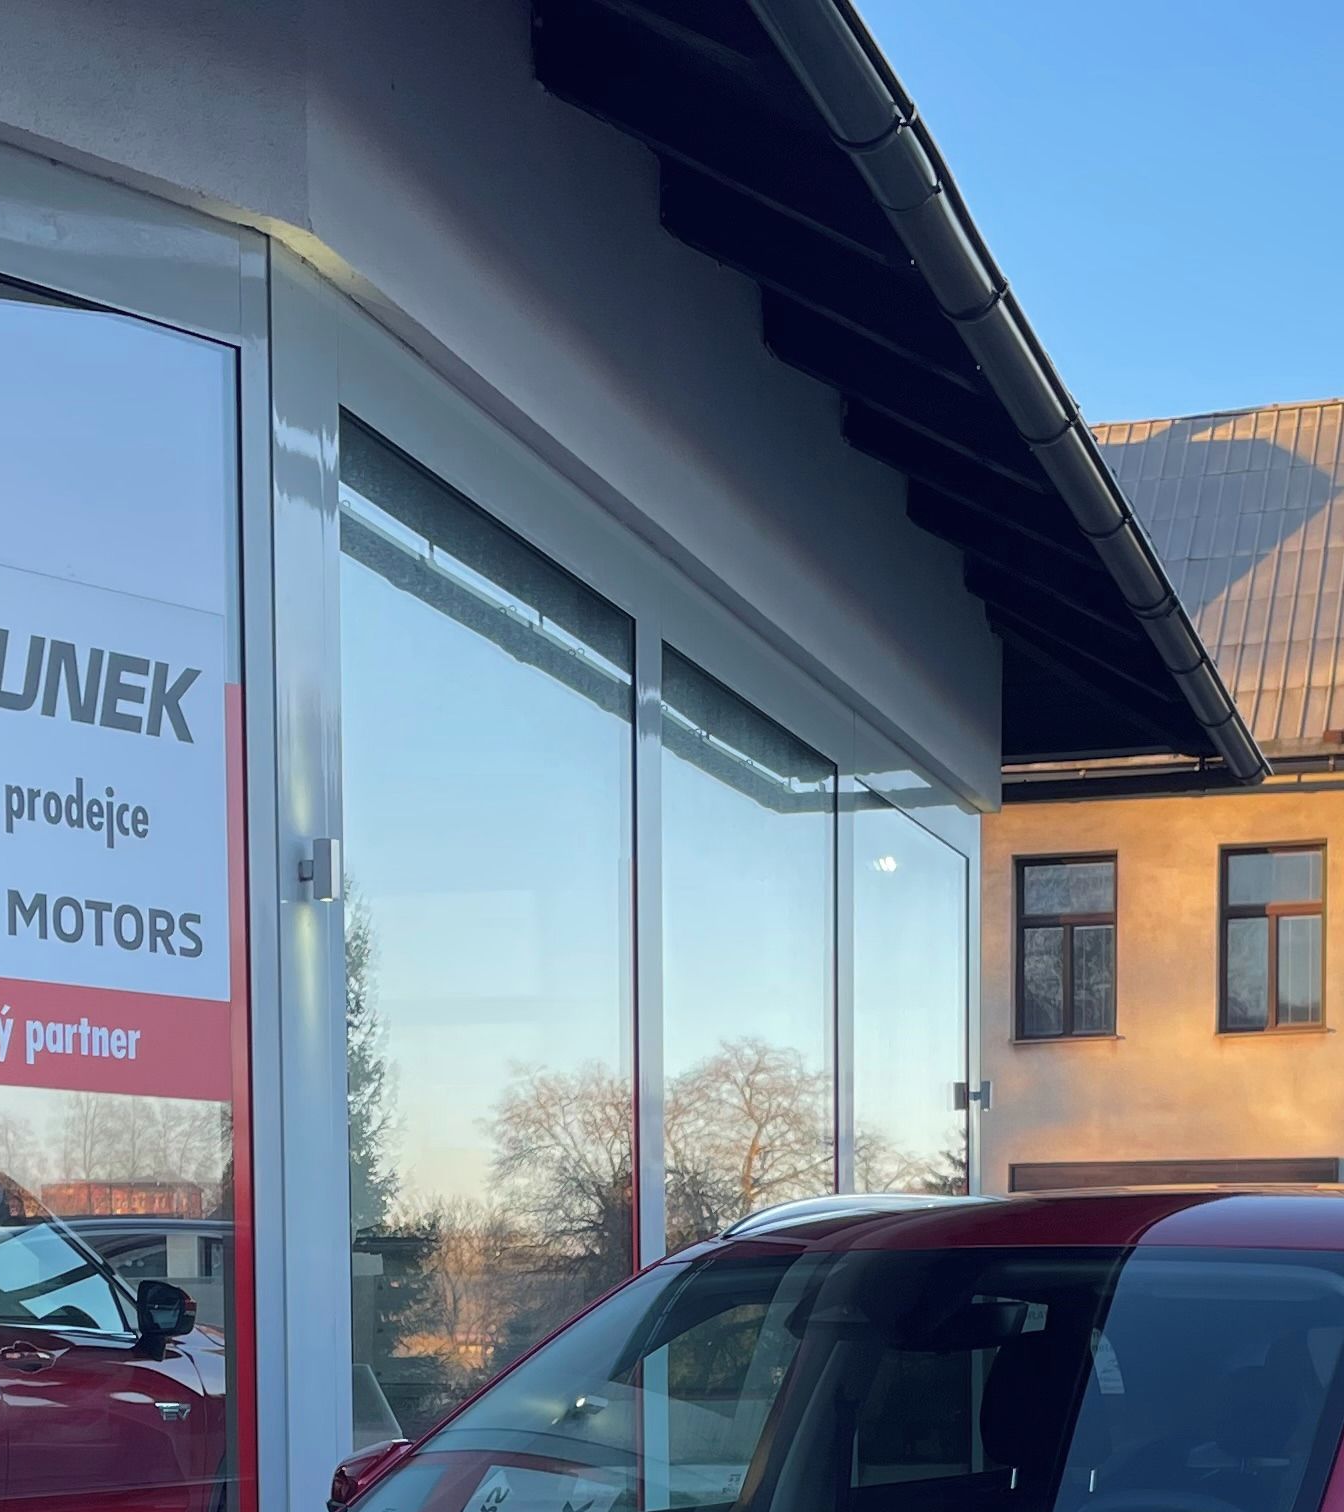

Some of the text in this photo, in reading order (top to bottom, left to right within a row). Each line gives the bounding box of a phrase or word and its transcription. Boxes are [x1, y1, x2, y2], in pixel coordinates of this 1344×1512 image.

[5, 777, 149, 848] prodejce
[7, 889, 203, 958] MOTORS
[26, 1012, 140, 1064] partner
